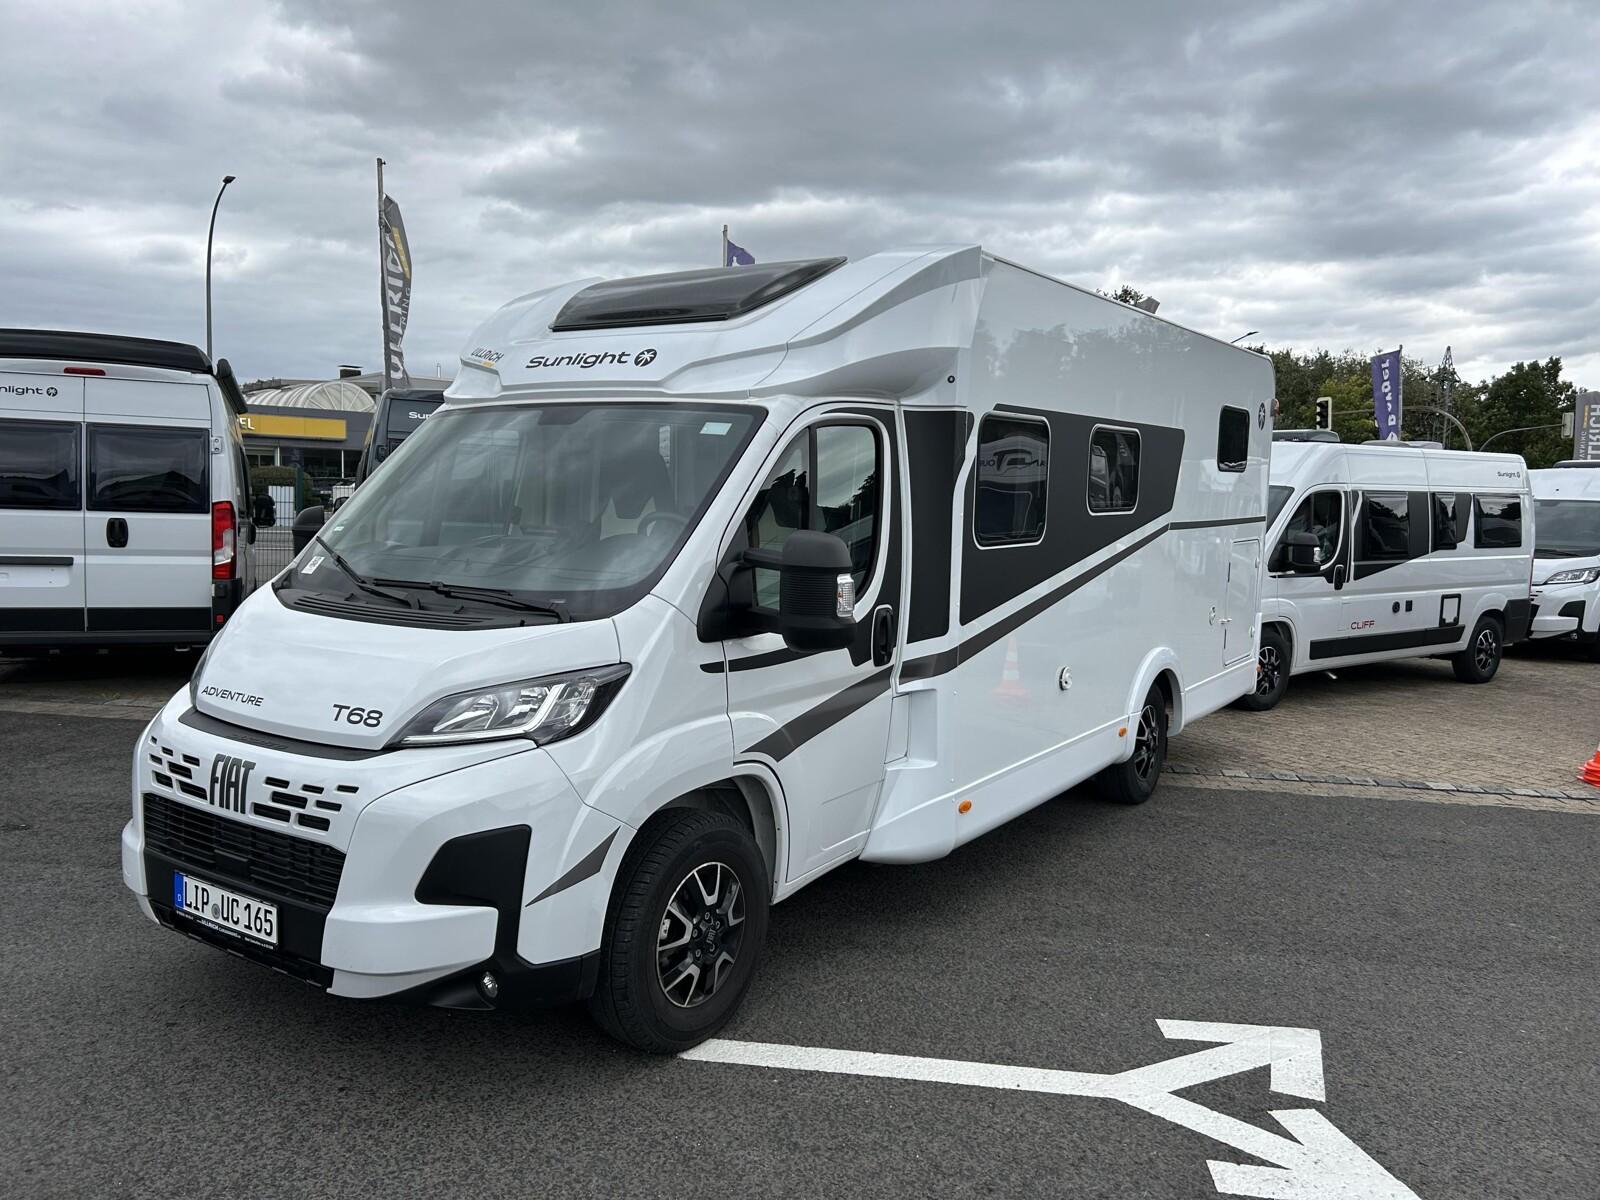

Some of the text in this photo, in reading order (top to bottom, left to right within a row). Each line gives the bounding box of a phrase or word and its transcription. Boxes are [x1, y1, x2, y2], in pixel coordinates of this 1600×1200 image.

[525, 351, 631, 369] Sunlight
[1351, 620, 1375, 630] CLIFF
[201, 685, 264, 707] ADVENTURE
[332, 704, 384, 728] T68
[209, 754, 256, 815] FIAT
[184, 880, 210, 913] LIP
[220, 894, 240, 926] UC
[244, 903, 274, 937] 165
